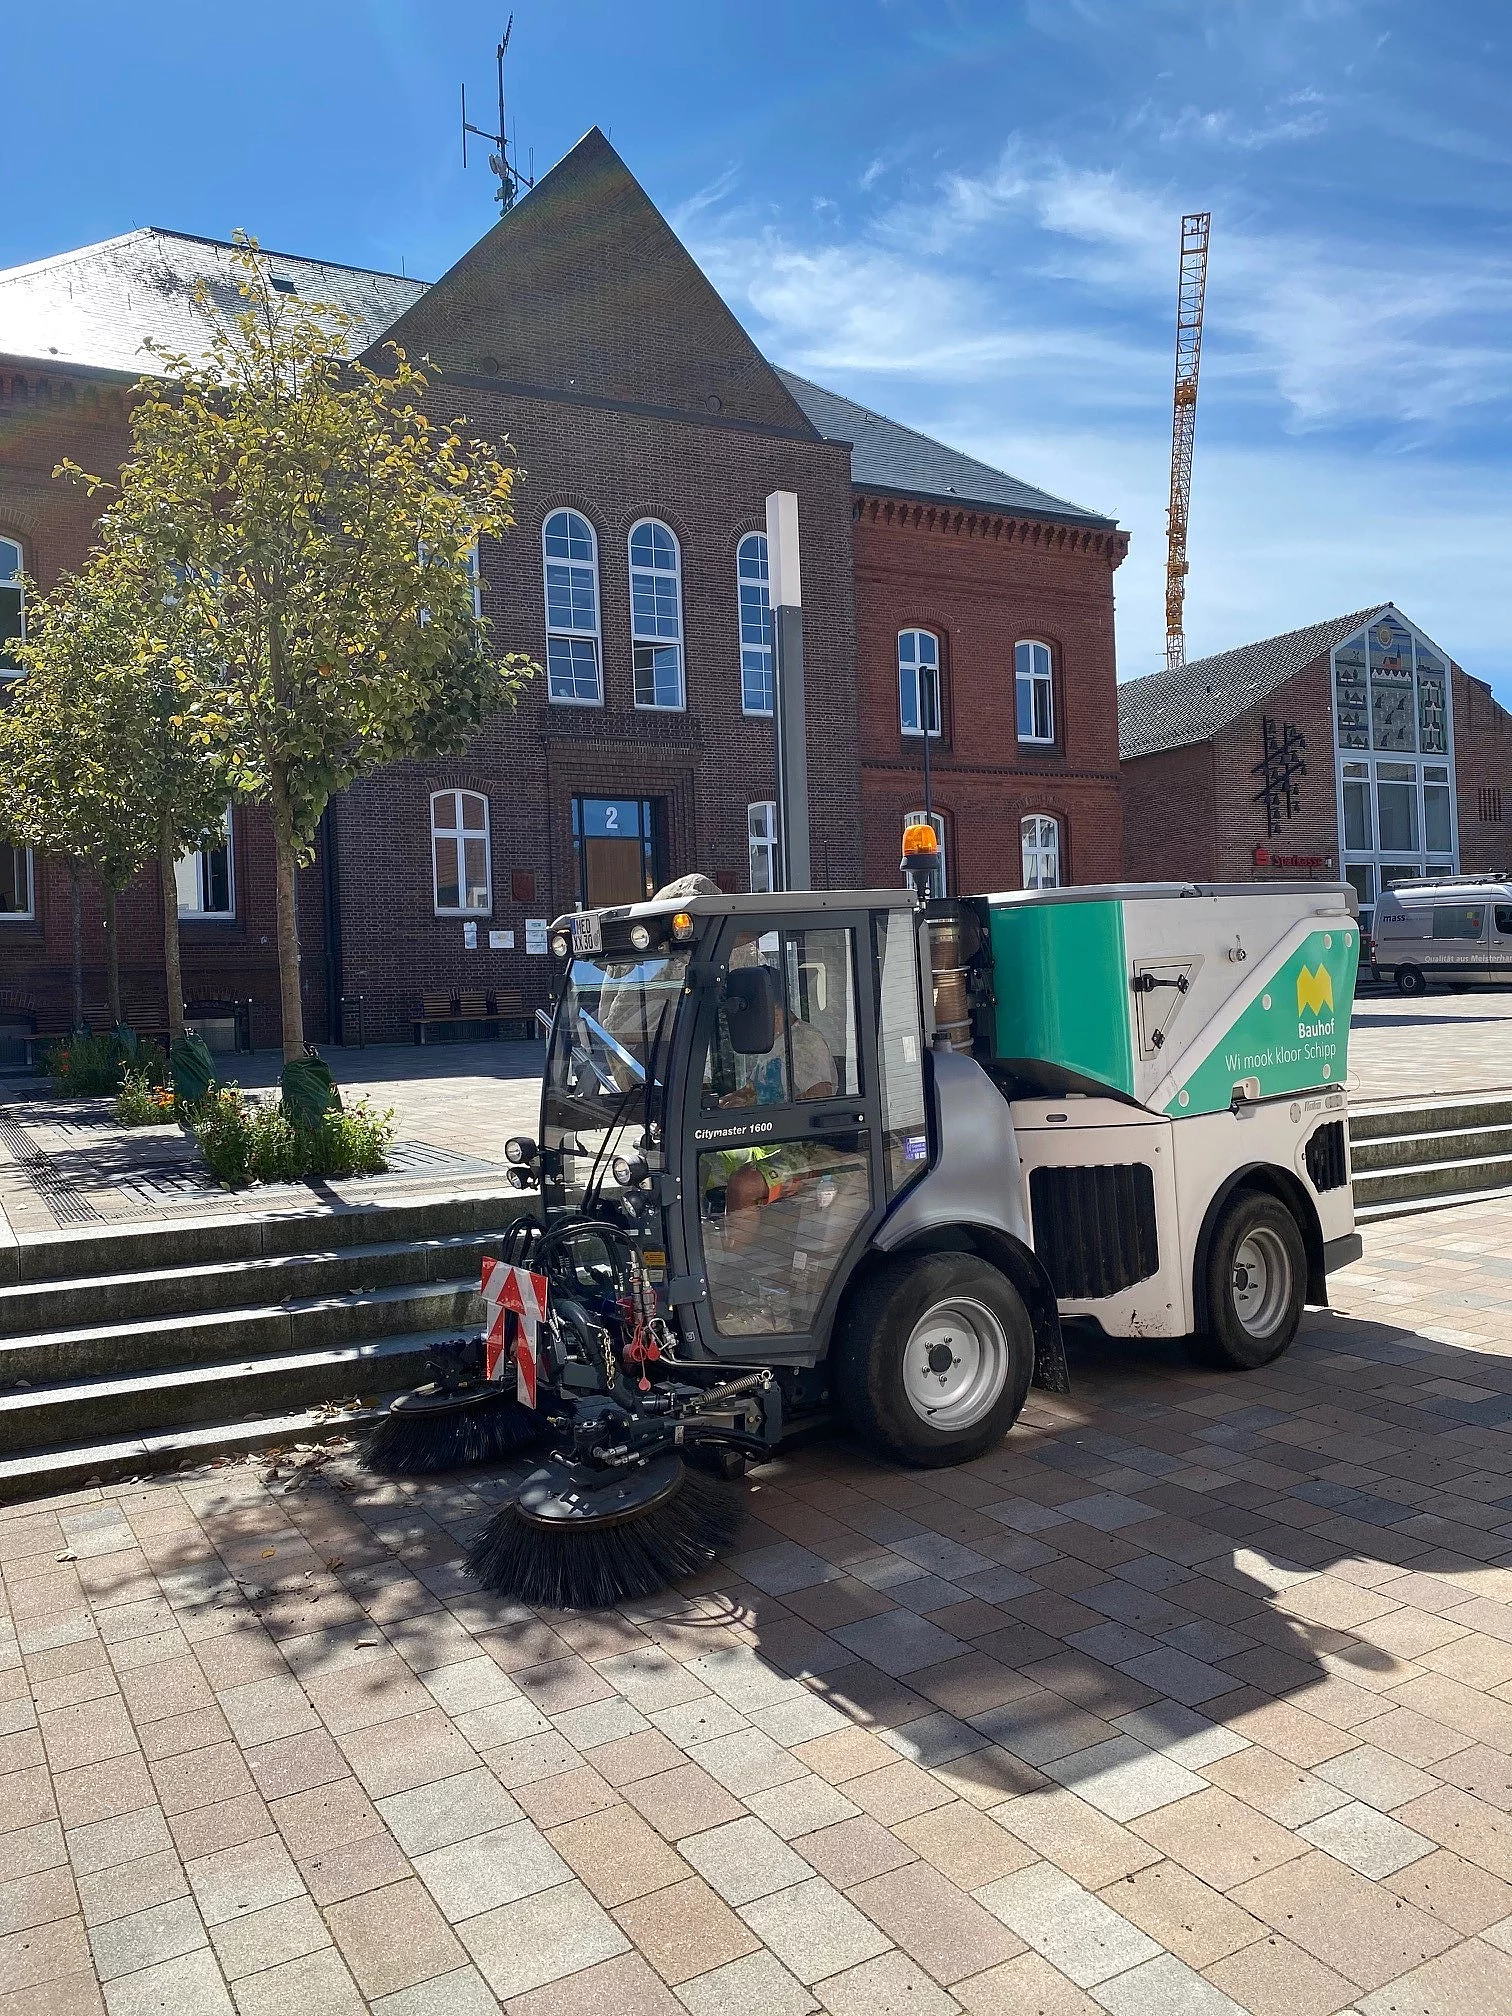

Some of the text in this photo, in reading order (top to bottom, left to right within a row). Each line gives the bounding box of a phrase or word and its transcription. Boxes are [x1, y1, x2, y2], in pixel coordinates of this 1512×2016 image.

[605, 806, 619, 829] 2
[1383, 914, 1406, 922] mass
[1298, 1018, 1335, 1039] Bauhof
[1225, 1042, 1336, 1072] Wi mook kloor Schipp
[694, 1122, 773, 1140] Citymaster 1600
